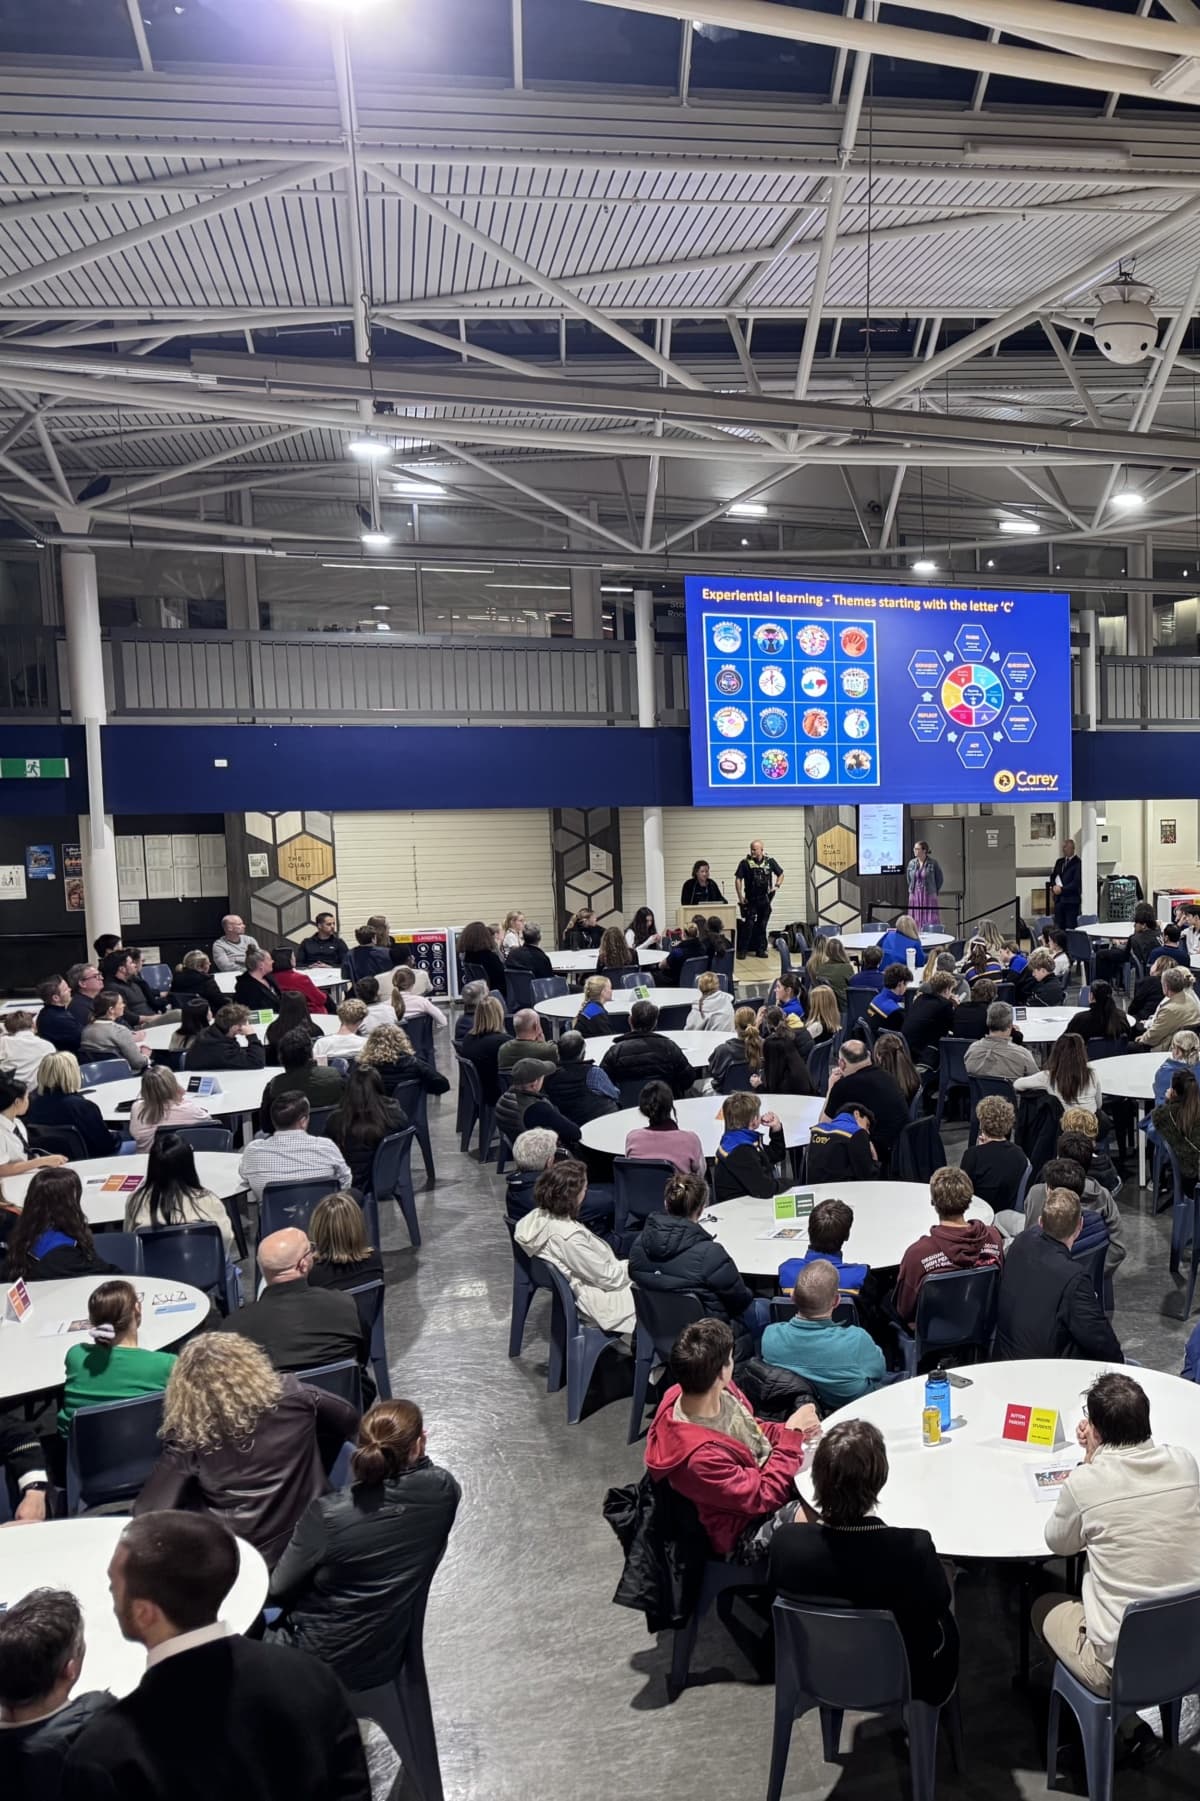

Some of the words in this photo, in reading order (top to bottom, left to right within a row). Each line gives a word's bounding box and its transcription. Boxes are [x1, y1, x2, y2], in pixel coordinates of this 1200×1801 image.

[702, 588, 773, 603] Experiential
[776, 591, 823, 607] learning
[832, 594, 876, 607] Themes
[879, 597, 921, 611] starting
[923, 598, 947, 610] with
[950, 599, 968, 611] the
[970, 600, 998, 612] letter
[1016, 771, 1058, 787] Carey
